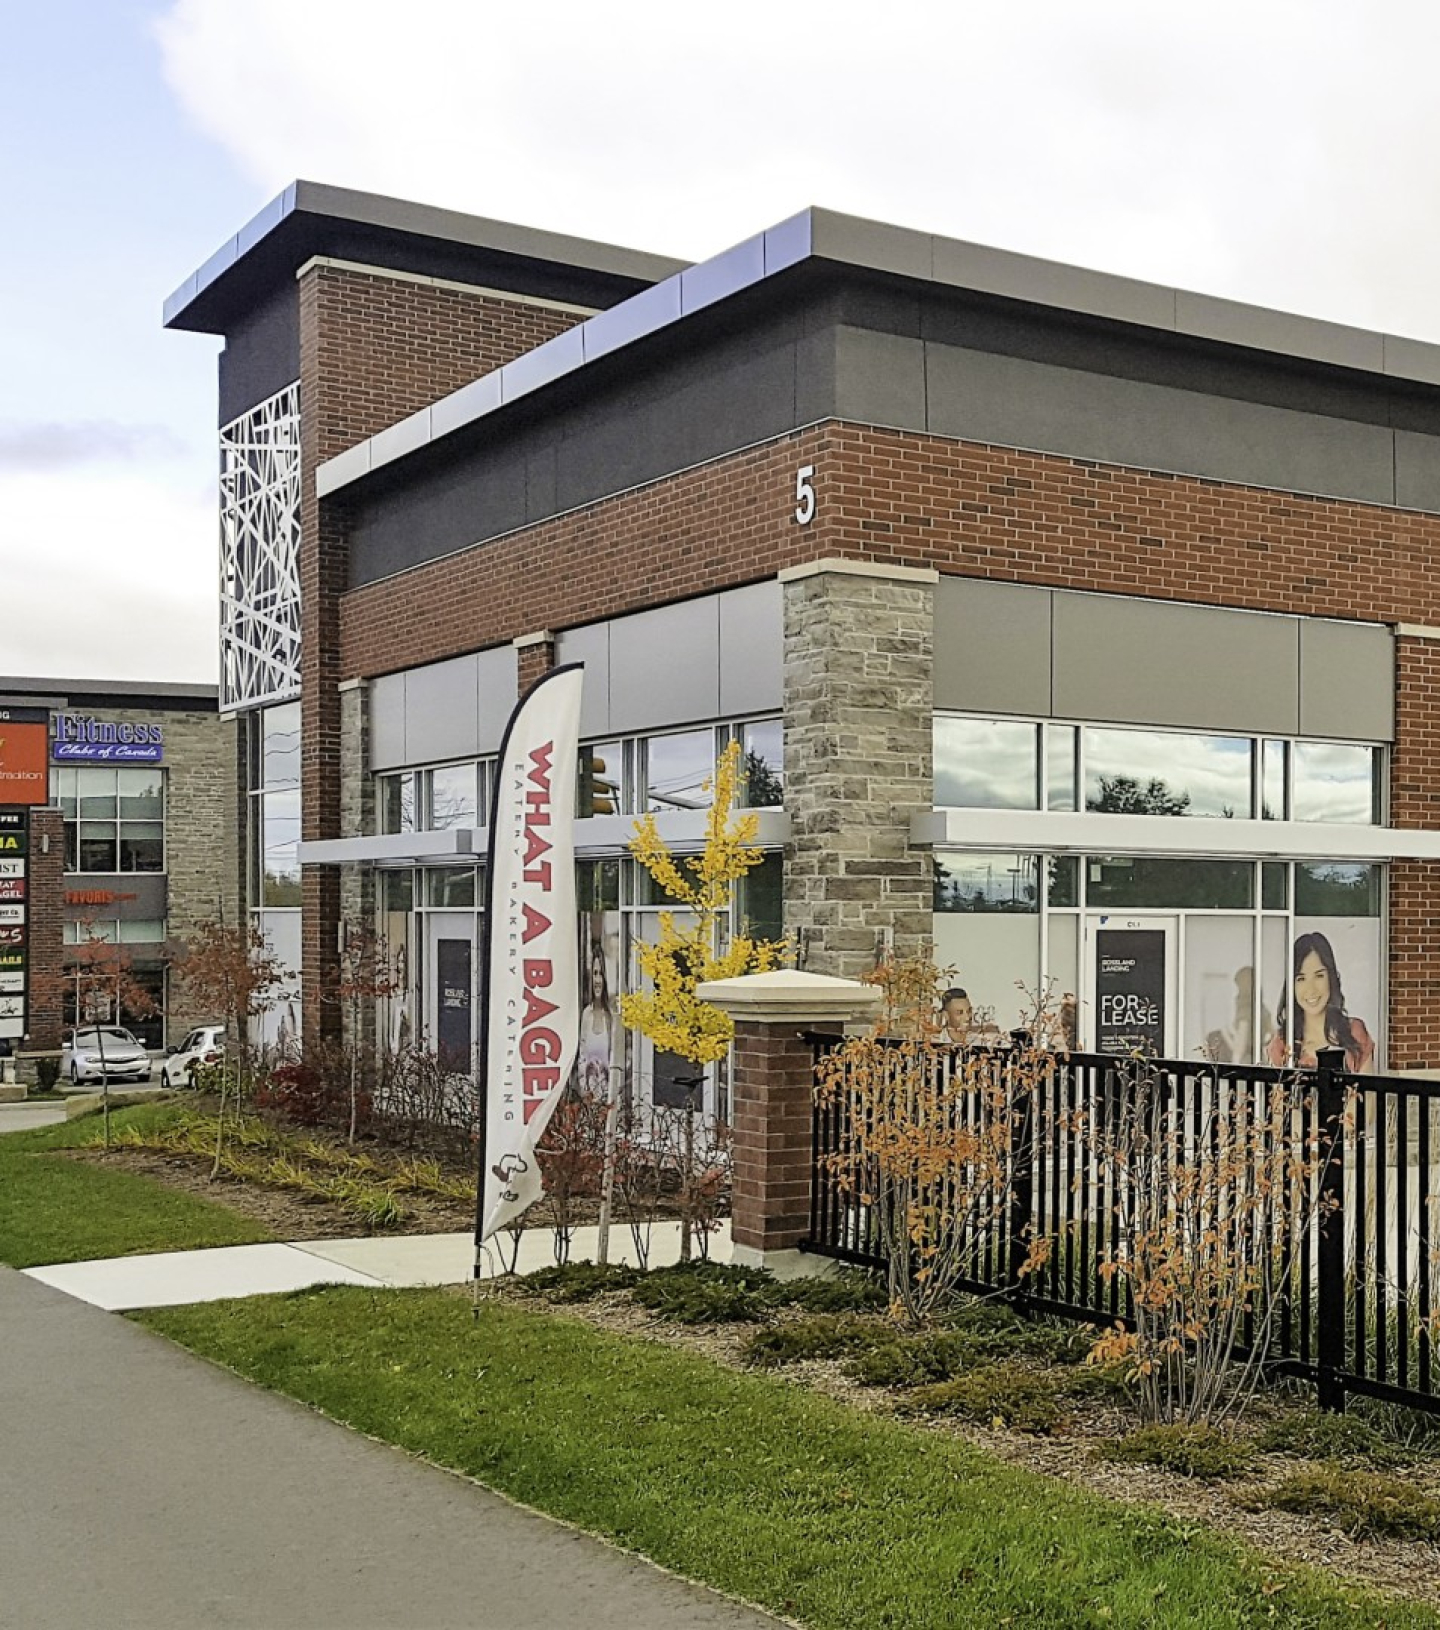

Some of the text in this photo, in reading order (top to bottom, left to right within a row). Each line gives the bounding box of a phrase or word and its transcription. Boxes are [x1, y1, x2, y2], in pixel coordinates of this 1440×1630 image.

[796, 465, 815, 525] 5
[54, 713, 164, 743] Fitness
[98, 747, 113, 758] of
[115, 745, 158, 757] Canada
[522, 740, 553, 892] WHAT
[521, 902, 552, 945] A
[504, 764, 525, 1121] EATERY BAKERY CATERING
[1101, 995, 1139, 1011] FOR
[1101, 1010, 1159, 1026] LEASE
